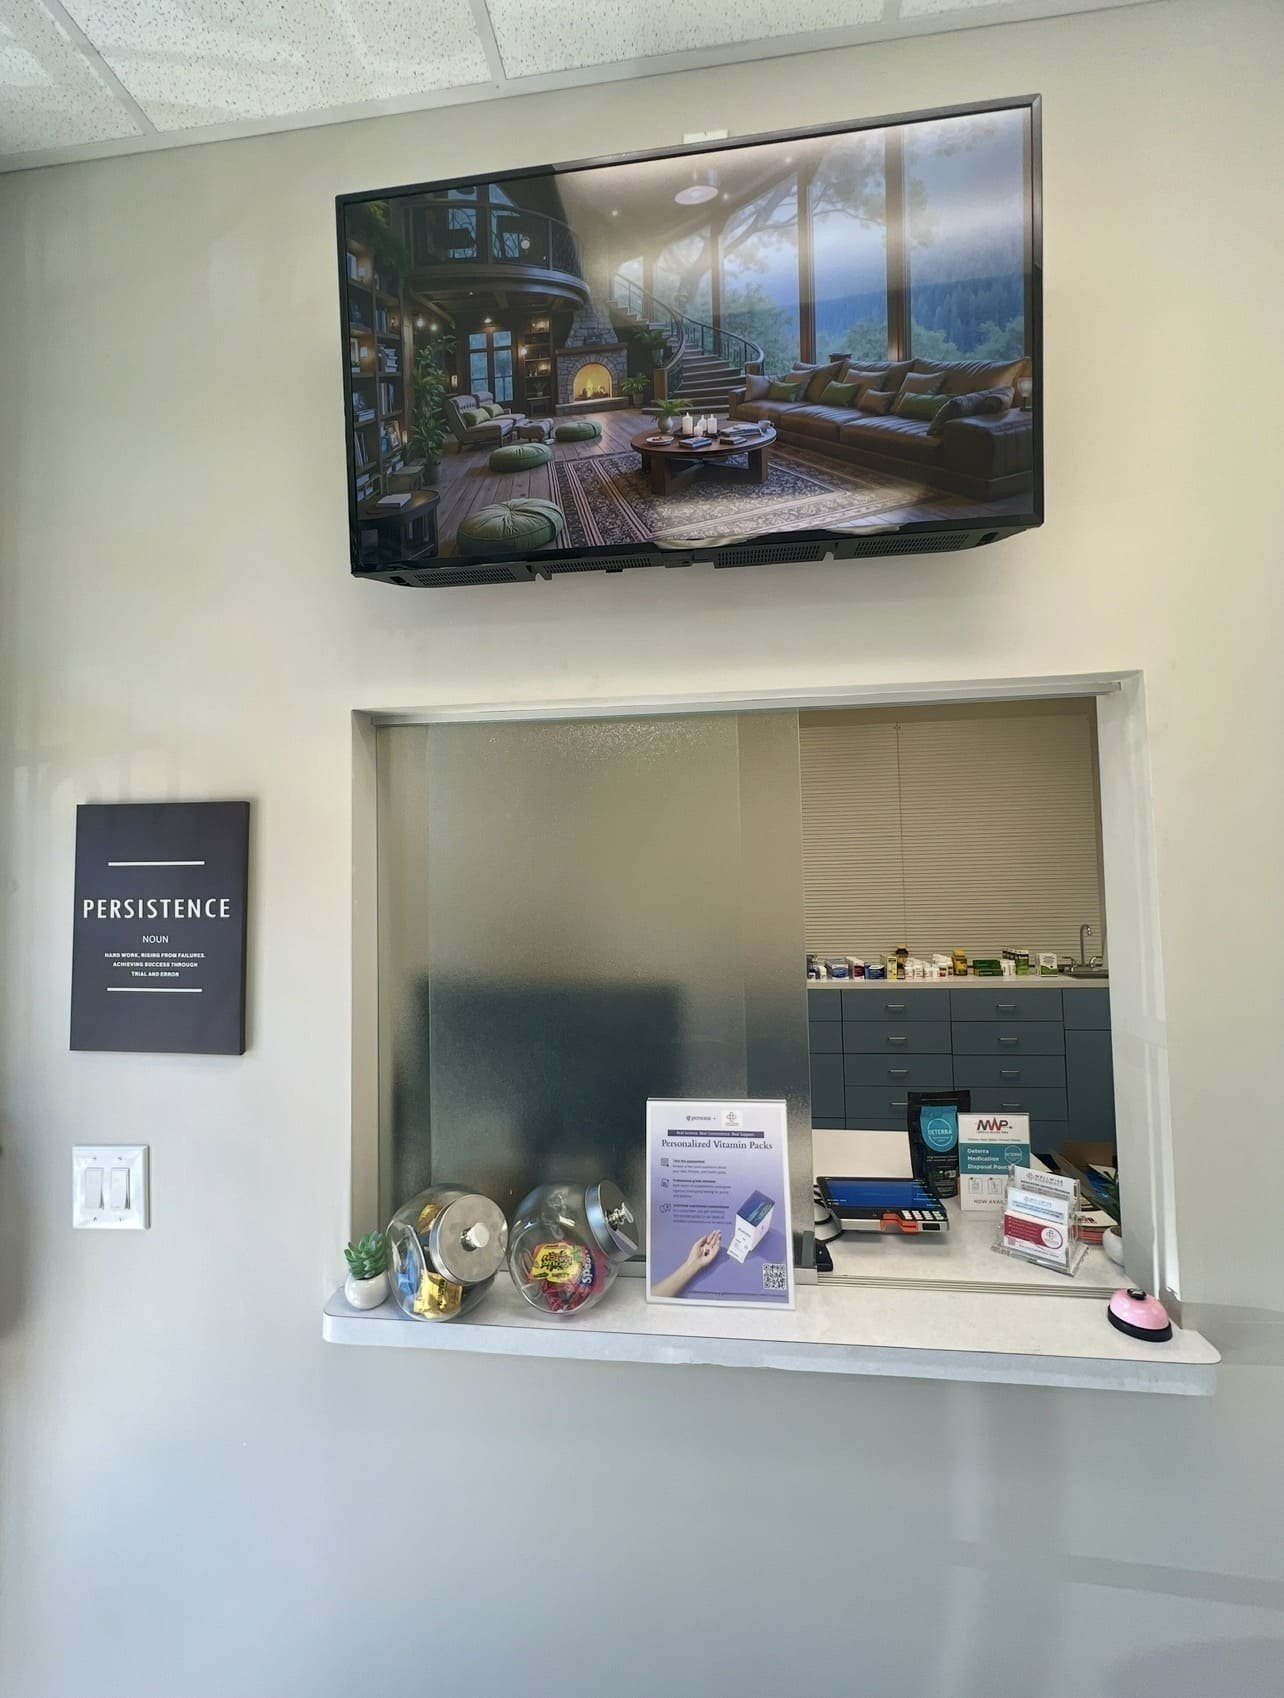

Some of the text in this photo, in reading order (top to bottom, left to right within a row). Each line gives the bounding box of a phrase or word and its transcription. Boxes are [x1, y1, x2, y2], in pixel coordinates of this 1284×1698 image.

[83, 898, 231, 919] PERSISTENCE
[142, 935, 169, 944] NOUN
[661, 1139, 773, 1150] Personalized Vitamin Packs
